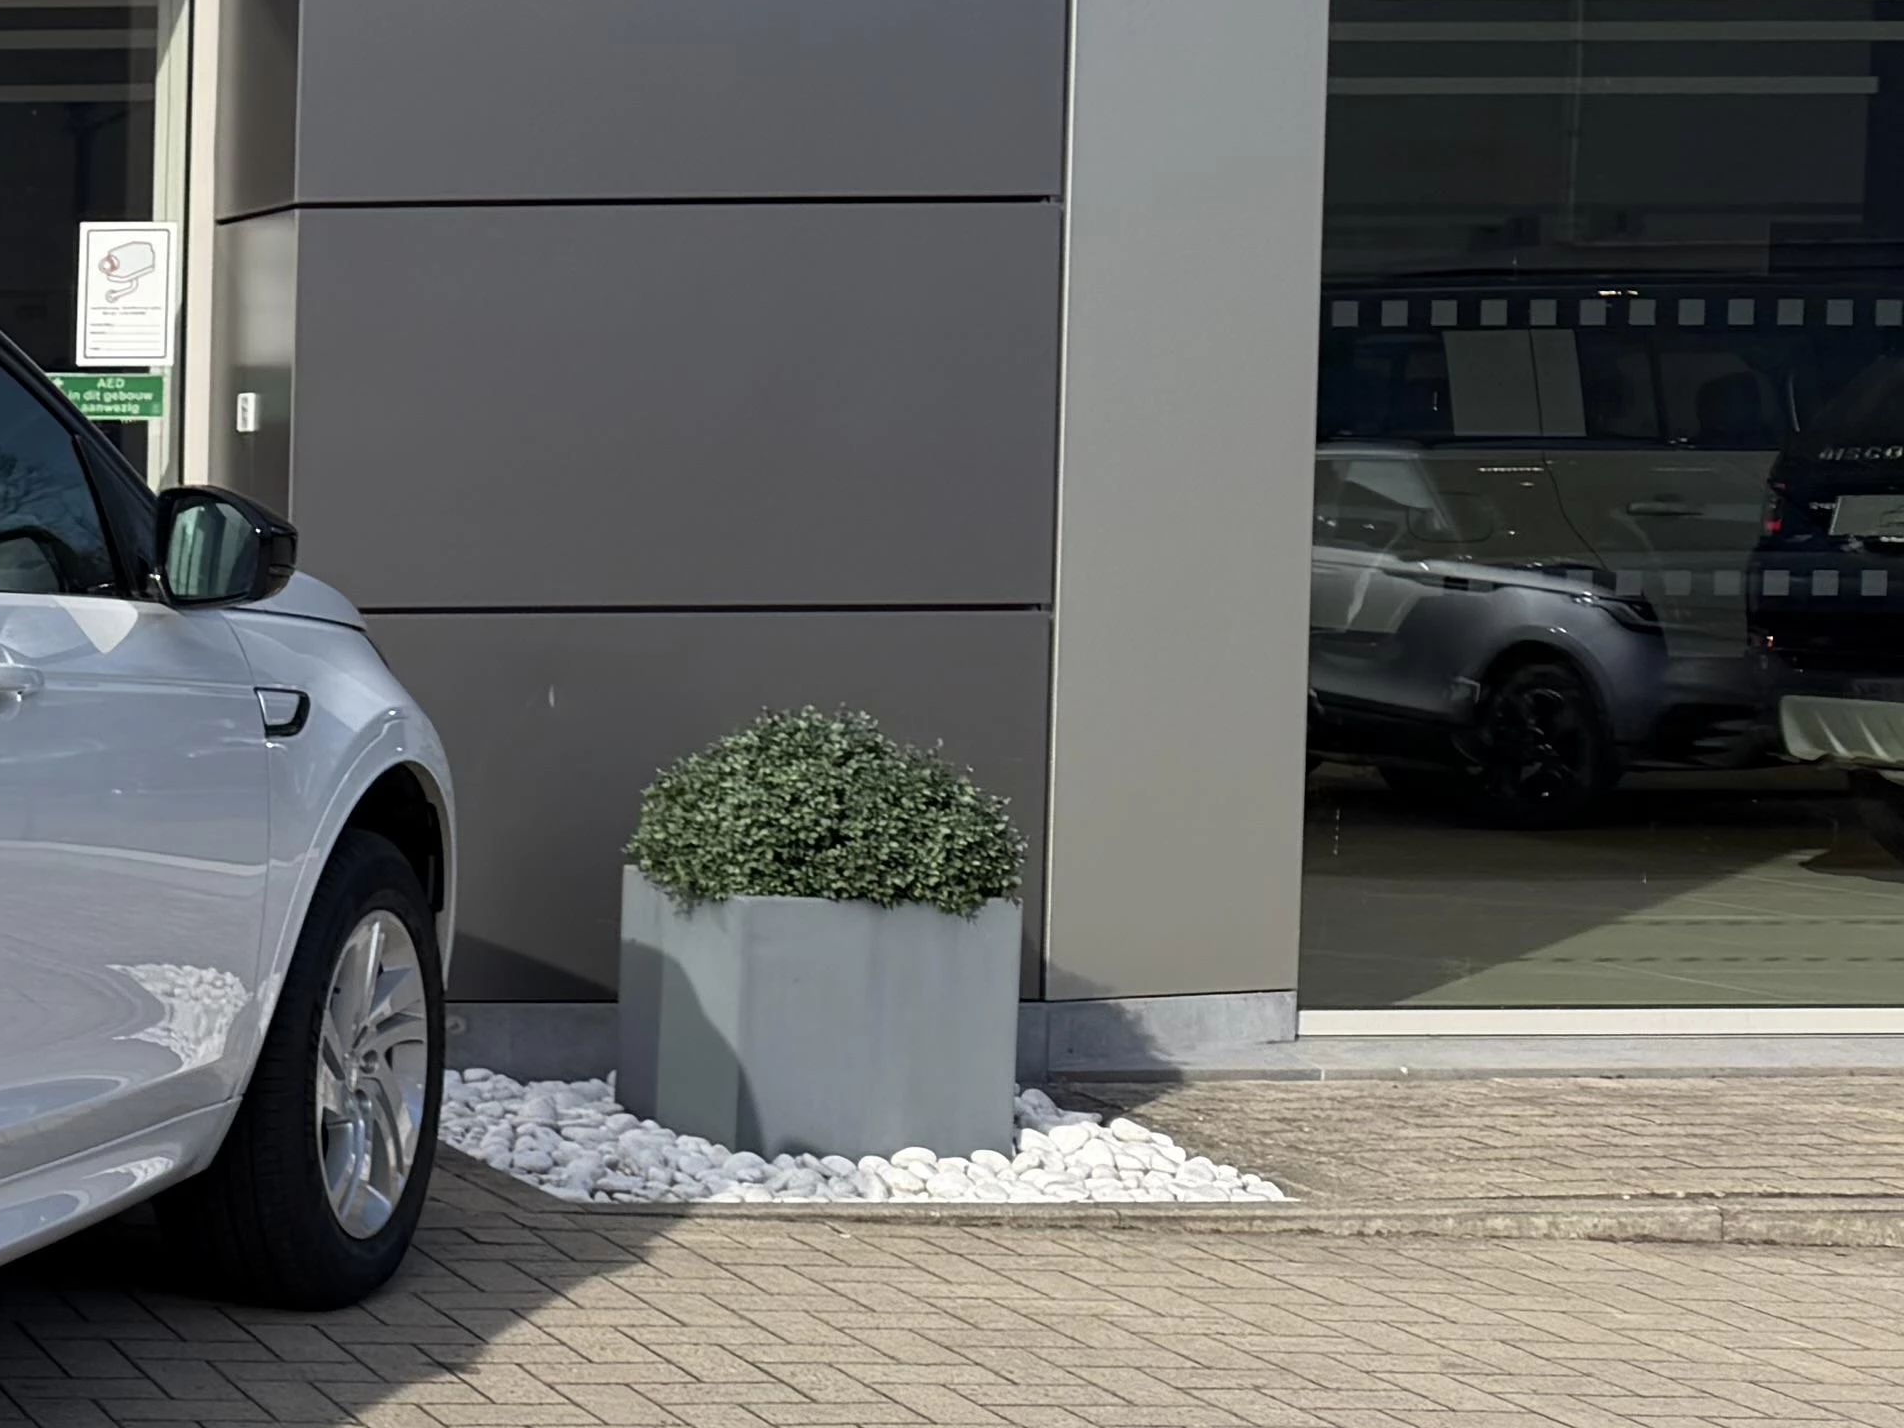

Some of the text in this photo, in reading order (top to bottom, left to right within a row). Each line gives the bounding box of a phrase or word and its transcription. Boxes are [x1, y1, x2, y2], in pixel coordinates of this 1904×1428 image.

[96, 377, 126, 390] AED
[82, 391, 101, 402] dit
[103, 390, 154, 403] gebouw
[81, 403, 140, 415] aanwezig
